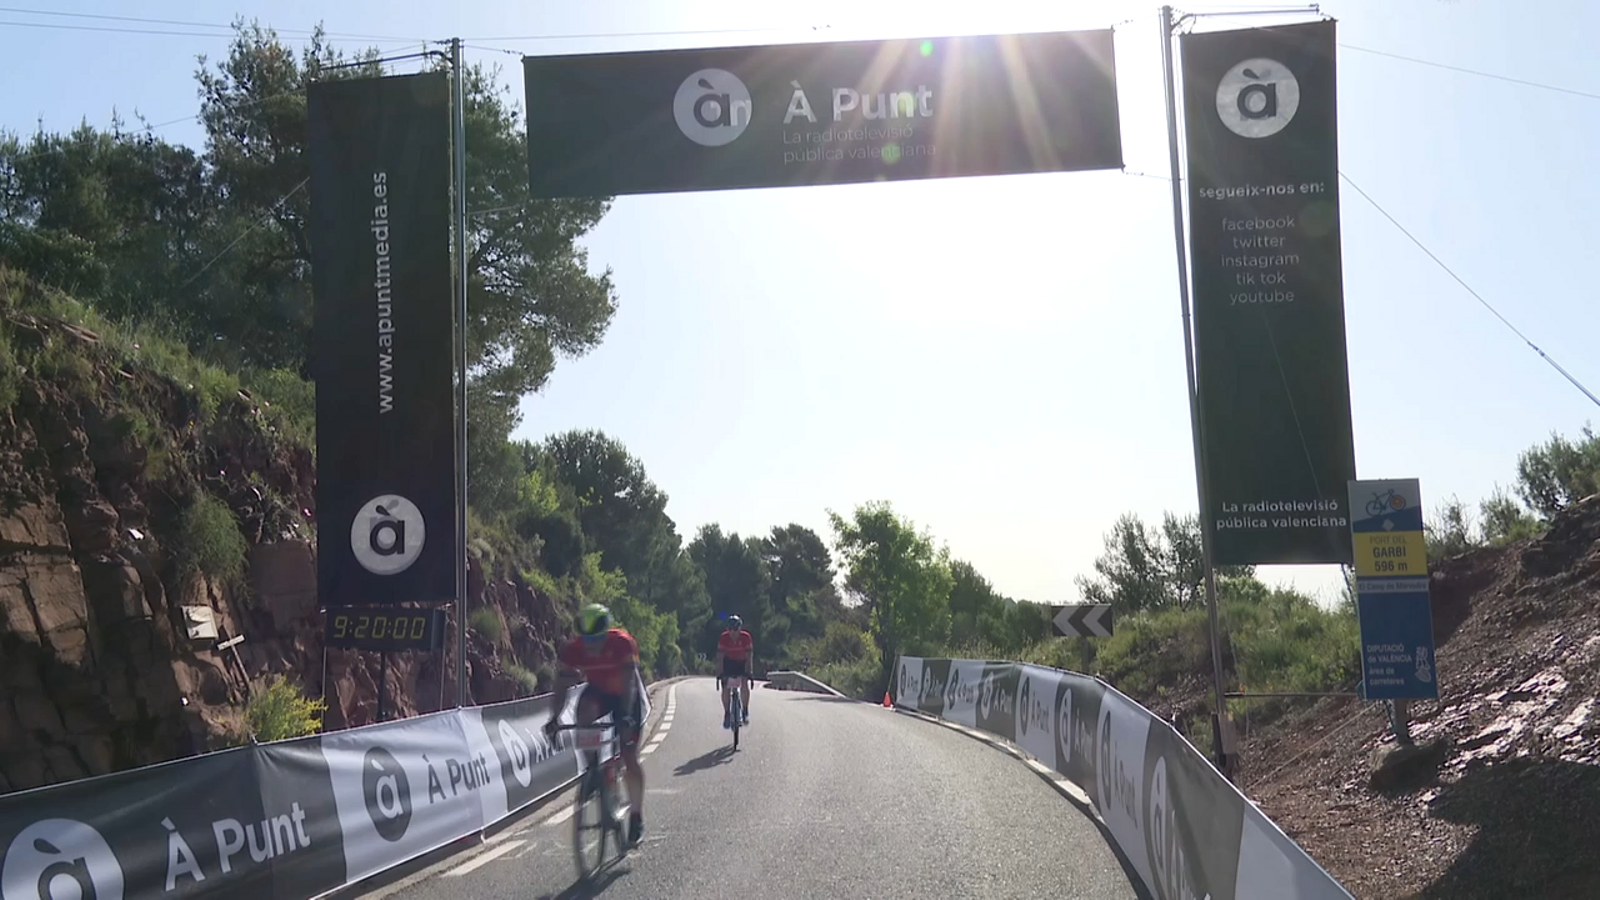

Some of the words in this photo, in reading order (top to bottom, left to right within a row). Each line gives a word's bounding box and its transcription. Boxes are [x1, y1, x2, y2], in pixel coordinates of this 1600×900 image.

[783, 80, 817, 124] À
[832, 84, 934, 122] Punt
[783, 130, 801, 144] La
[806, 123, 913, 143] radiotelevisió
[848, 142, 936, 159] valenciana
[1199, 182, 1295, 199] segueix-nos
[1300, 181, 1325, 194] en:
[1222, 215, 1295, 231] facebook
[1233, 236, 1286, 249] twitter
[1221, 252, 1299, 269] instagram
[1236, 272, 1255, 285] tik
[1260, 271, 1286, 284] tok
[371, 171, 395, 415] www.apuntmedia.es
[1230, 290, 1294, 305] youtube
[1222, 501, 1238, 512] La
[1243, 499, 1338, 512] radiotelevisió
[1216, 516, 1267, 530] pública
[1271, 516, 1347, 527] valenciana
[1374, 560, 1395, 572] 596
[1398, 562, 1408, 571] m
[333, 616, 426, 639] 9:20:00
[422, 754, 446, 805] À
[449, 752, 491, 796] Punt
[161, 816, 206, 893] À
[212, 801, 311, 874] Punt
